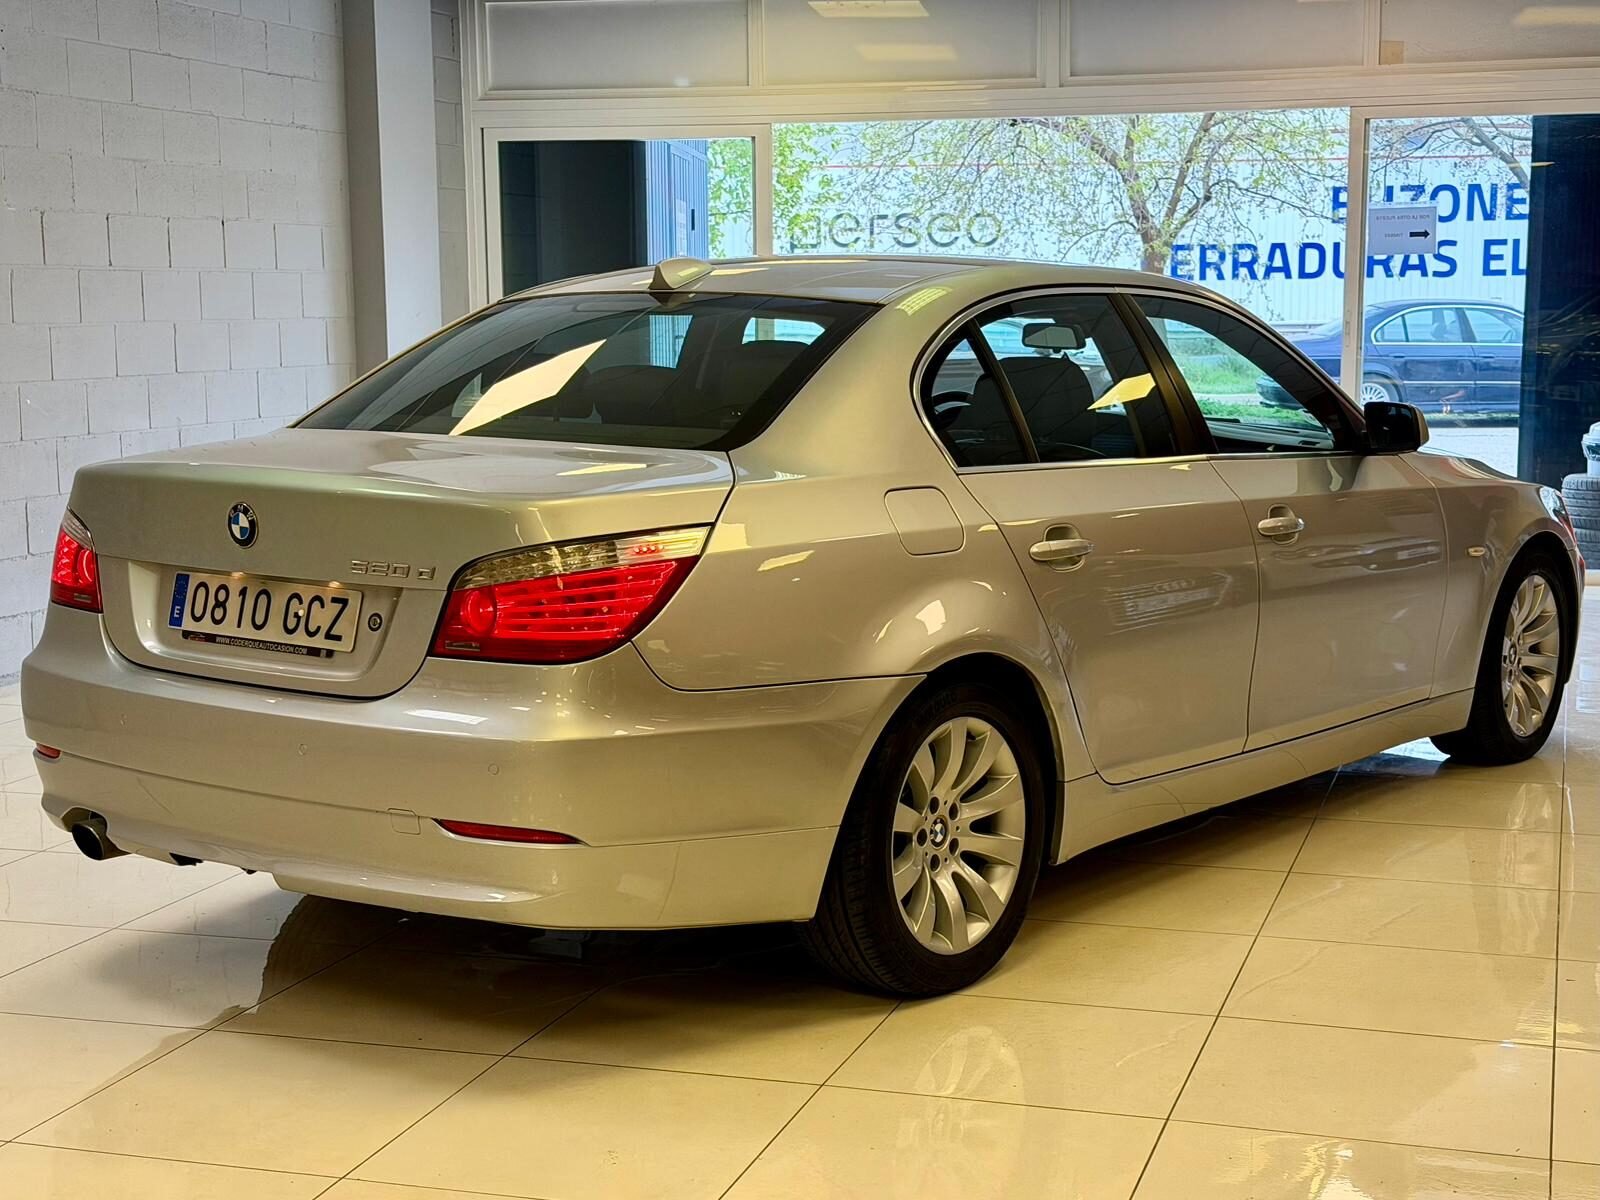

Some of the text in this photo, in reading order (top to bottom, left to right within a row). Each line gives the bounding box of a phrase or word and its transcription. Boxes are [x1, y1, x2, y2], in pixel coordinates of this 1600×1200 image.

[1332, 183, 1528, 224] BONE
[351, 560, 411, 579] 520
[173, 605, 181, 618] E
[190, 581, 350, 642] 0810 GCZ
